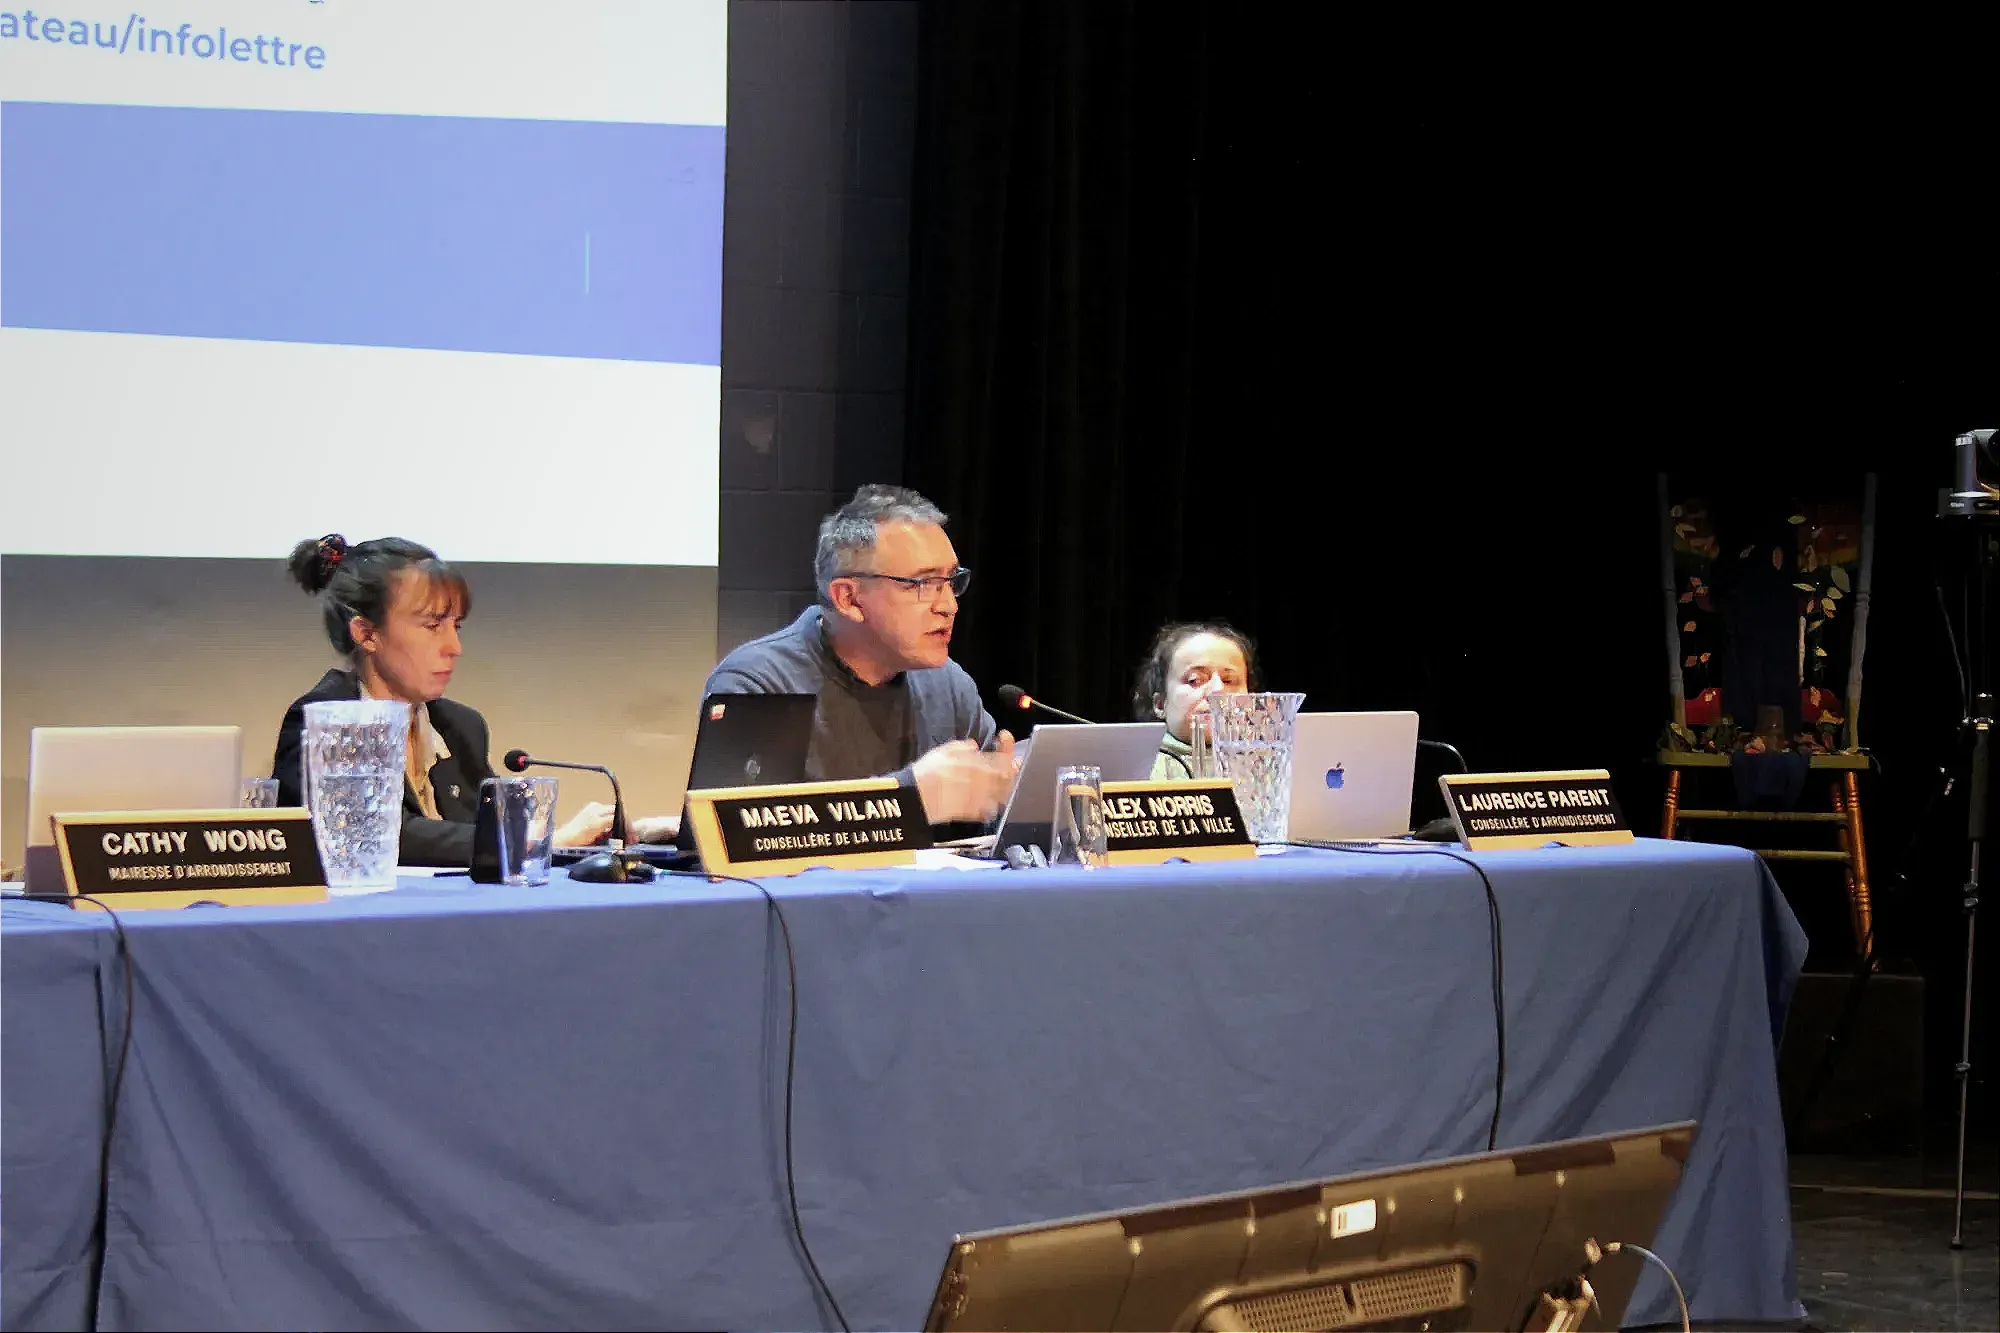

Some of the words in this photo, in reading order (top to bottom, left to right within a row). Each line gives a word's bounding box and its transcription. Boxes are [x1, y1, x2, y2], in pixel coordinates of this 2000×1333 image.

[0, 10, 327, 69] ateau/infolettre
[1102, 797, 1146, 820] ALEX
[1149, 794, 1214, 818] NORRIS
[1458, 791, 1548, 812] LAURENCE
[1548, 788, 1610, 809] PARENT
[739, 803, 819, 828] MAEVA
[826, 798, 902, 822] VILAIN
[1470, 815, 1530, 832] CONSEILLÈRE
[1531, 813, 1616, 829] D'ARRONDISSEMENT
[755, 831, 832, 851] CONSEILLÈRE
[835, 833, 850, 845] DE
[854, 830, 869, 844] LA
[871, 828, 904, 843] VILLE
[1086, 820, 1160, 839] NSEILLER
[1162, 819, 1180, 836] DE
[1182, 818, 1200, 835] LA
[1202, 816, 1235, 834] VILLE
[102, 831, 187, 855] CATHY
[203, 828, 287, 853] WONG
[108, 865, 172, 882] MAIRESSE
[174, 861, 291, 880] D'ARRONDISSEMENT
